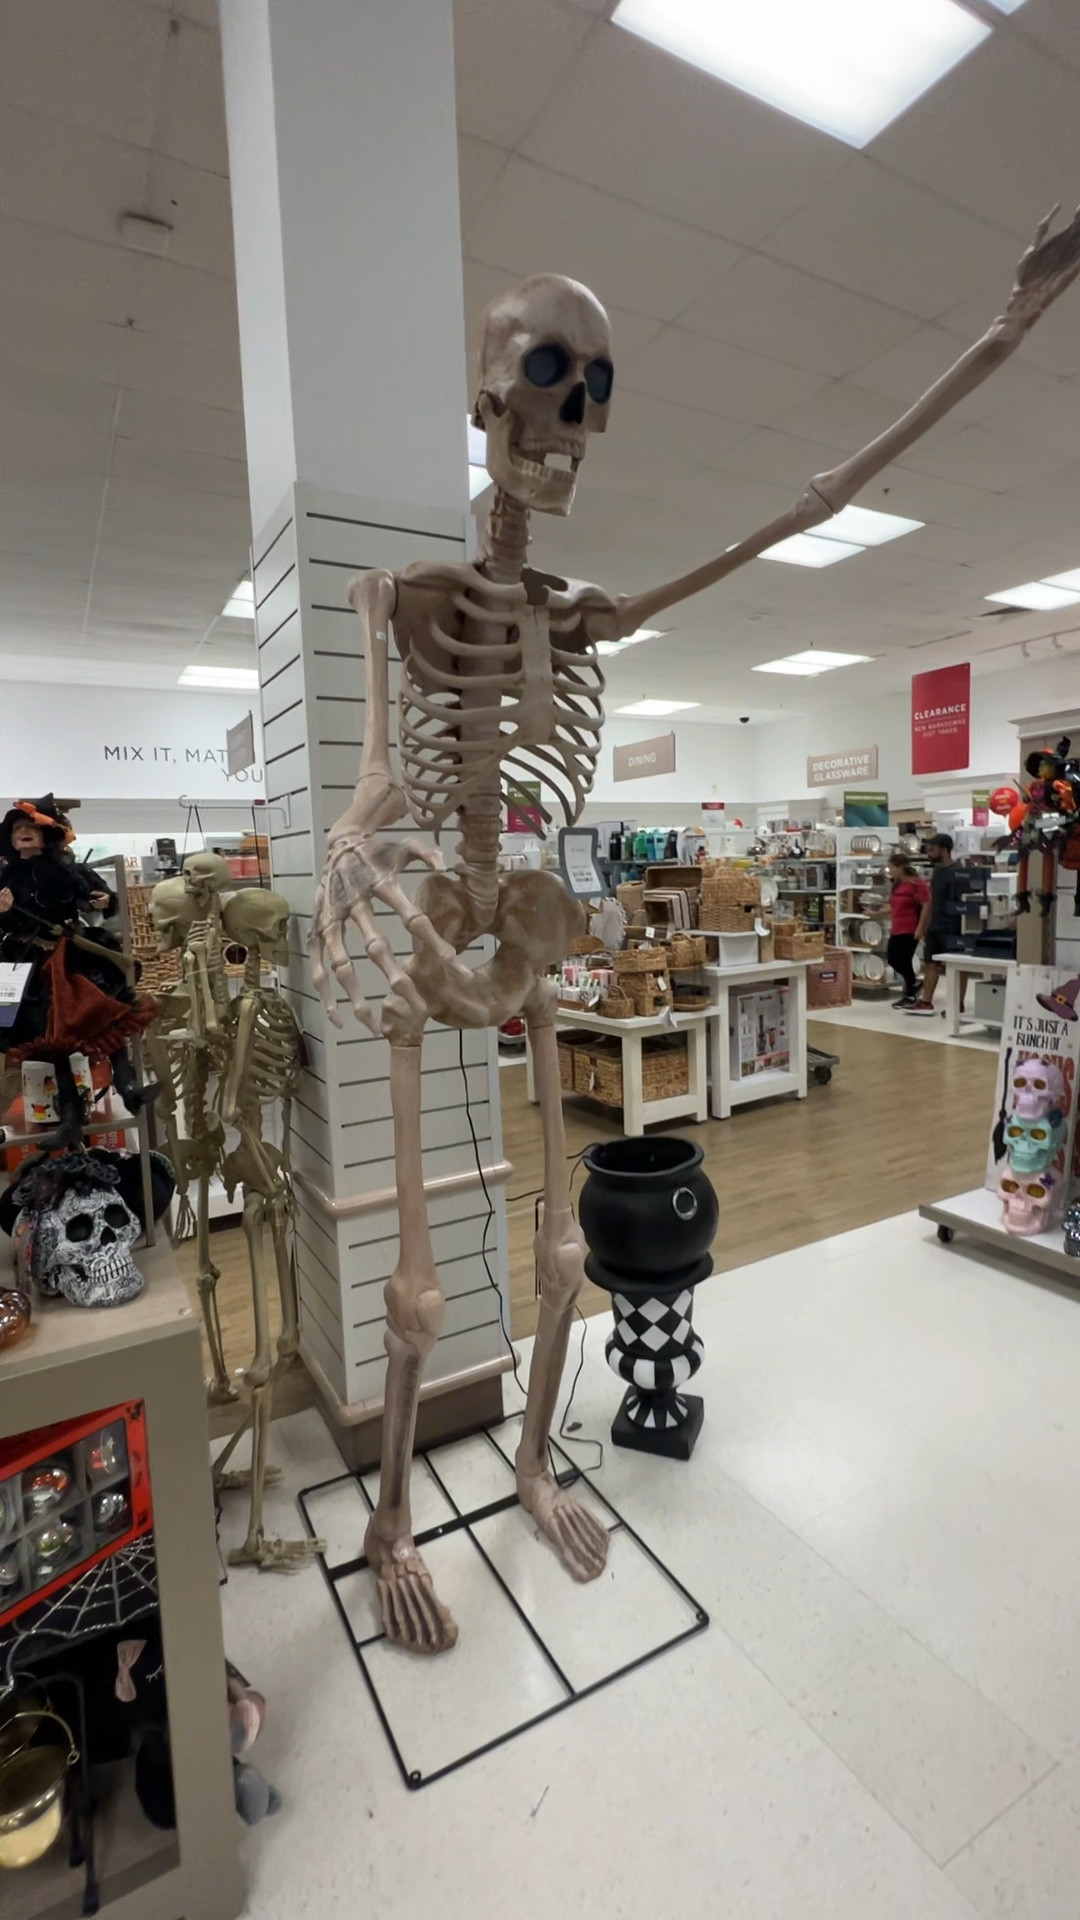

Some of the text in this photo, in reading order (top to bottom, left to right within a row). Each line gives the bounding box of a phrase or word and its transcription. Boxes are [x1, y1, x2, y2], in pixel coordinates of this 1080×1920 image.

[914, 703, 967, 720] CLEARANCE
[103, 745, 144, 761] MIX
[154, 747, 177, 763] IT,
[628, 751, 656, 768] DINING
[812, 754, 870, 772] DECORATIVE
[814, 766, 869, 782] GLASSWARE
[1034, 1018, 1060, 1034] JUST
[1061, 1022, 1068, 1036] A
[1016, 1032, 1061, 1051] BUNCH OF
